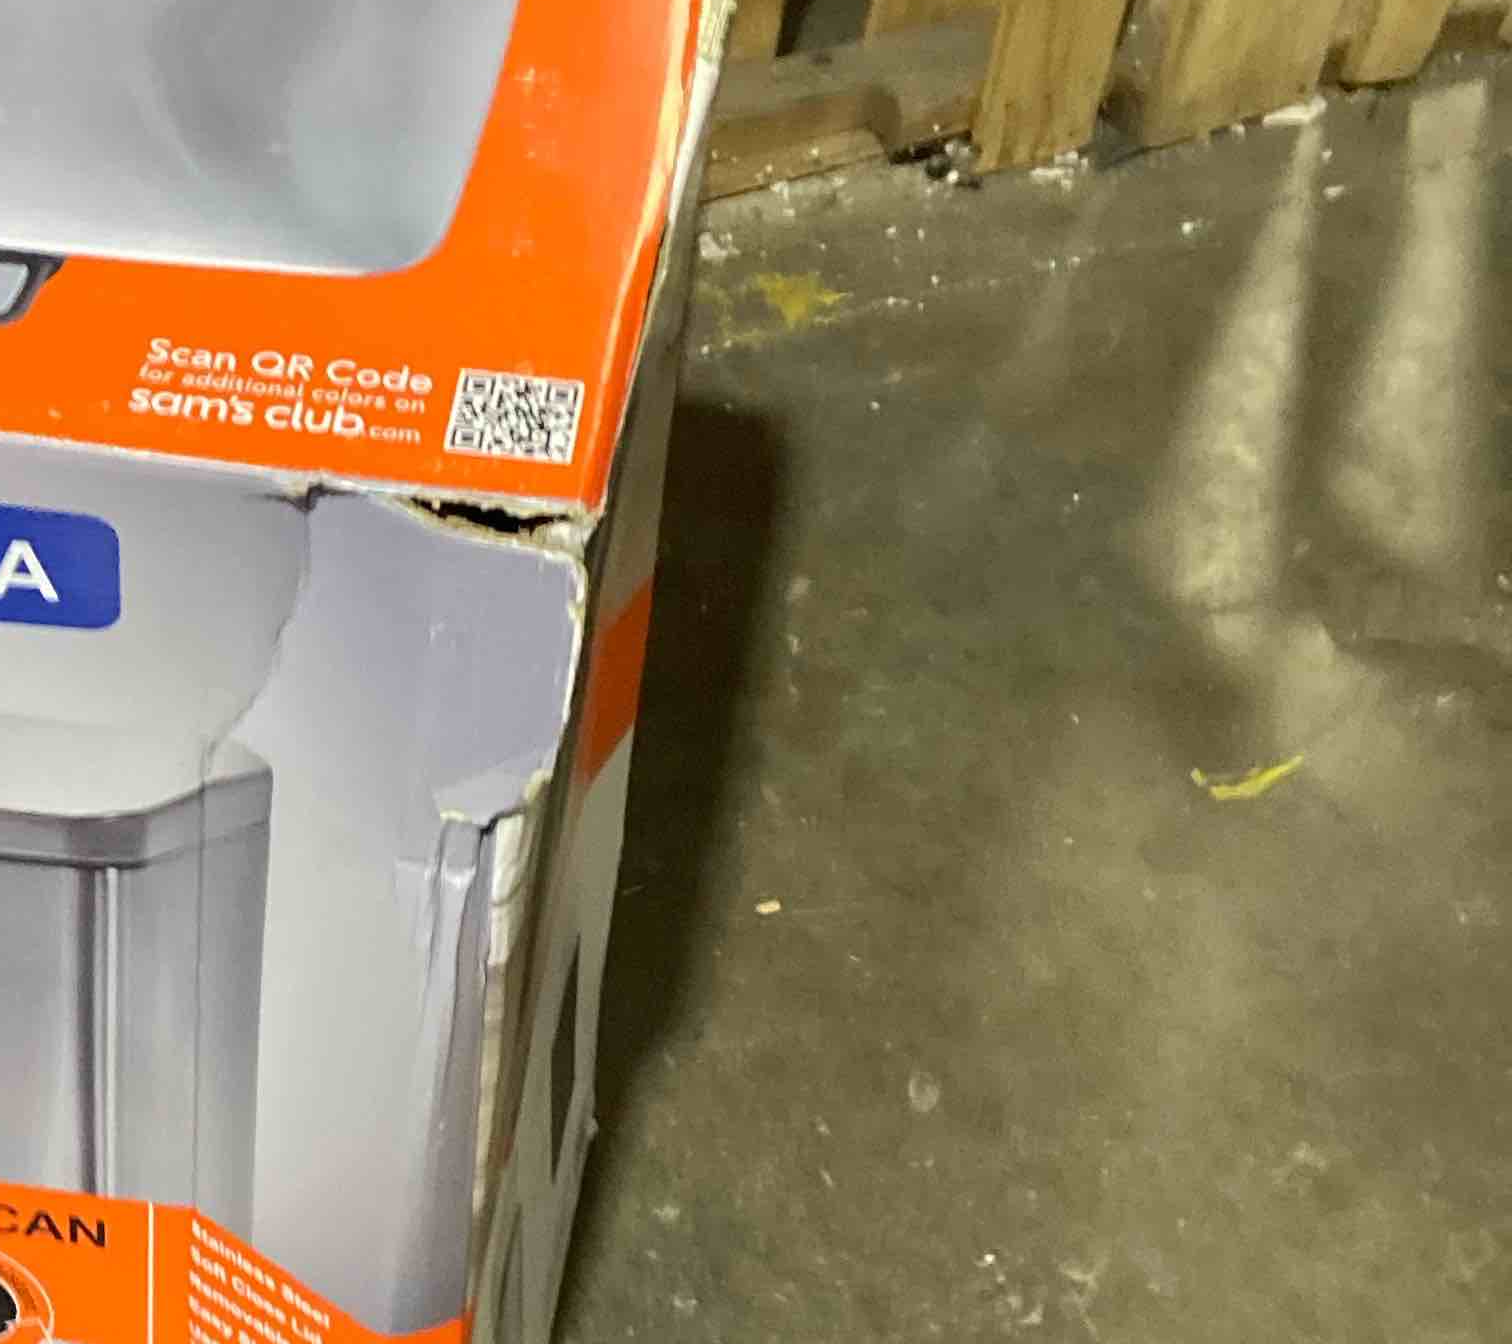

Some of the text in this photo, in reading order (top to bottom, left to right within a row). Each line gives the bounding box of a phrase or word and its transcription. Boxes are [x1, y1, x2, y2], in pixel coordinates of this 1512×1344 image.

[138, 361, 426, 415] for additional colors on
[145, 336, 434, 396] Scan QR Code
[128, 387, 256, 427] sam's
[190, 1244, 228, 1286] Soft
[231, 1273, 287, 1325] Close
[191, 1218, 331, 1331] Stainless Steel
[188, 1293, 234, 1341] Easy
